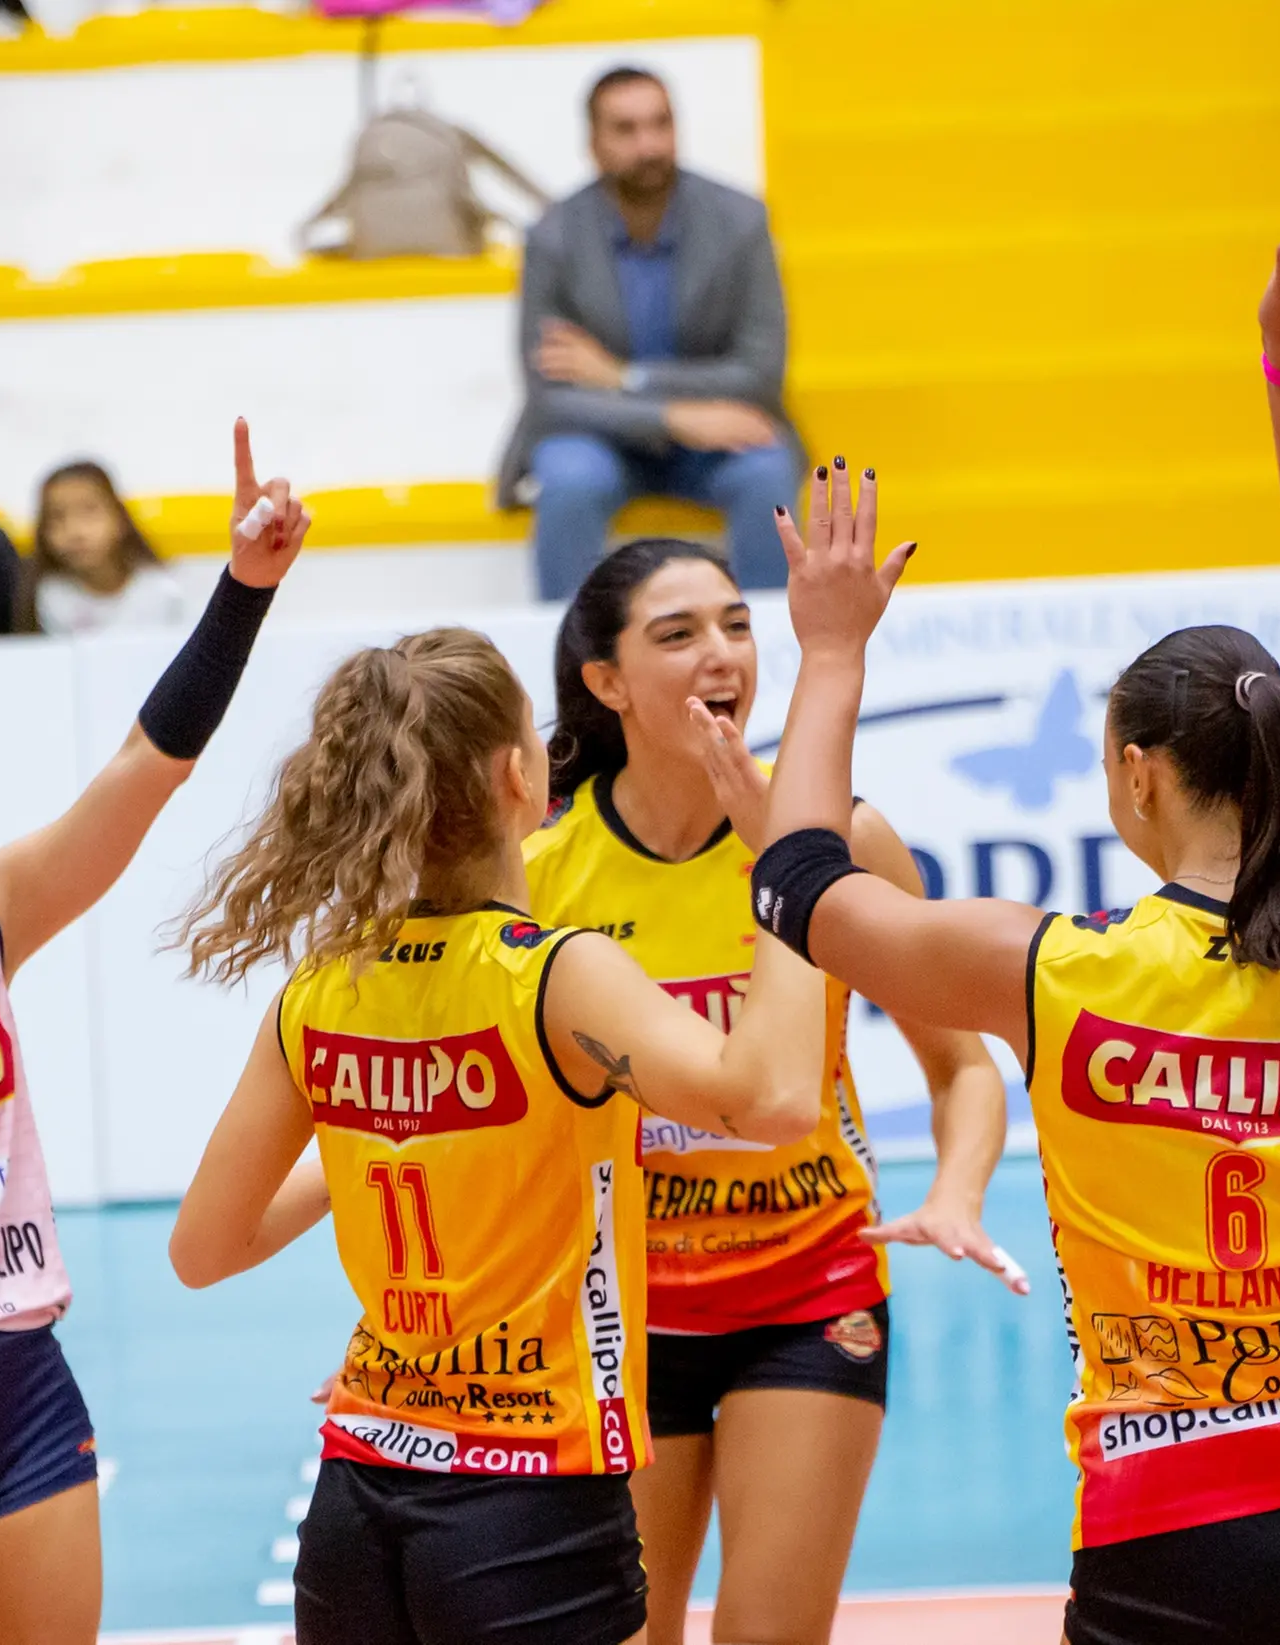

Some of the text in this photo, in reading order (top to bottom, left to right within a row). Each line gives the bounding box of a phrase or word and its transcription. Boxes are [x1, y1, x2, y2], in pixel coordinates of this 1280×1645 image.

[378, 938, 448, 964] Zeus
[373, 1117, 395, 1131] DAL
[1201, 1115, 1270, 1135] DAL 1913
[726, 1154, 848, 1215] CALLIPO
[365, 1161, 445, 1281] 11
[1205, 1150, 1269, 1272] 6
[382, 1287, 454, 1338] CURTI
